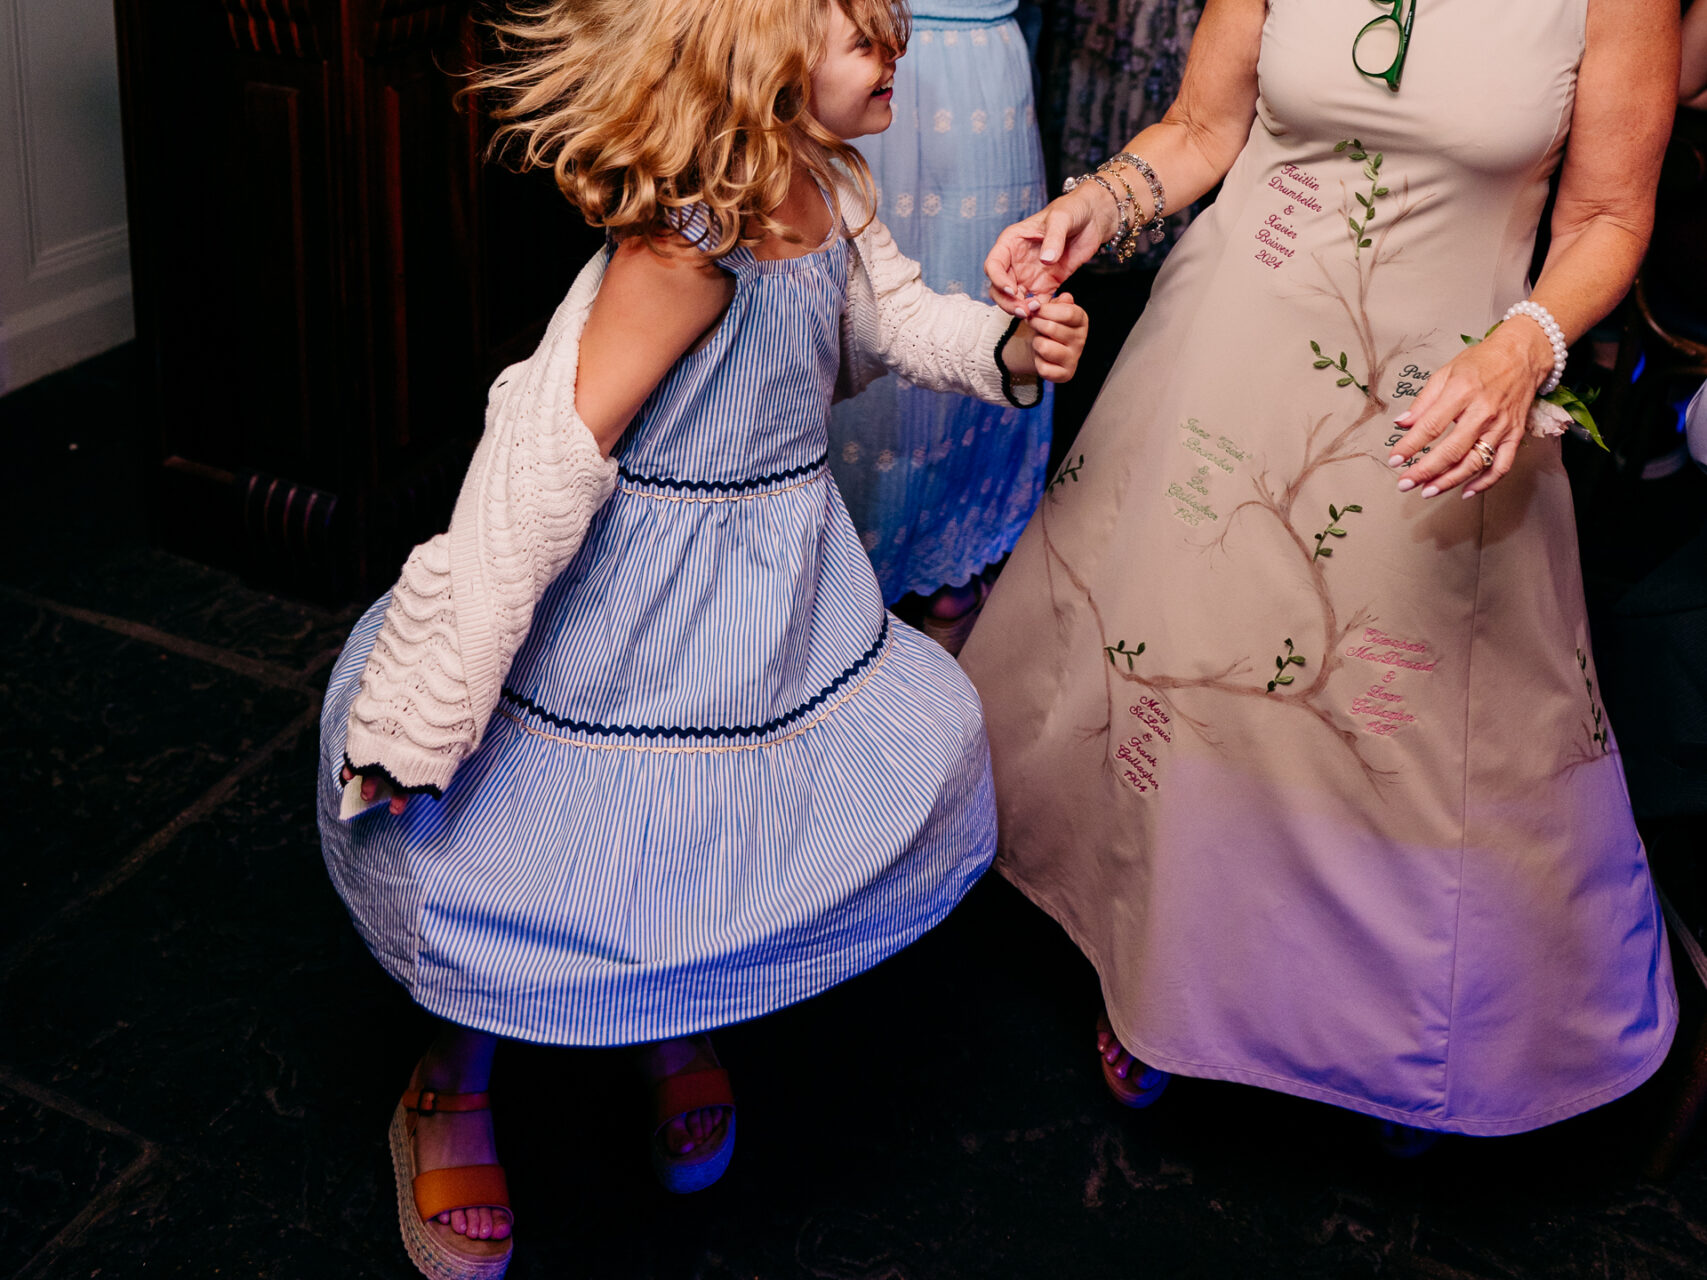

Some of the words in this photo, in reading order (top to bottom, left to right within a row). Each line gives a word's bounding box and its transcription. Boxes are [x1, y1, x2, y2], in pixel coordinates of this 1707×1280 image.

[1281, 162, 1320, 191] Kaitlin
[1268, 176, 1322, 213] Drumheller
[1283, 204, 1295, 216] &
[1264, 214, 1297, 239] Xavier
[1255, 228, 1295, 257] Boisvert
[1254, 249, 1283, 270] 2024
[1398, 364, 1431, 381] Pat
[1392, 381, 1423, 399] Gal
[1198, 465, 1209, 476] &
[1382, 670, 1396, 683] &
[1139, 695, 1170, 725] Mary
[1142, 733, 1152, 743] &
[1128, 737, 1157, 767] Frank
[1124, 770, 1147, 793] 1904
